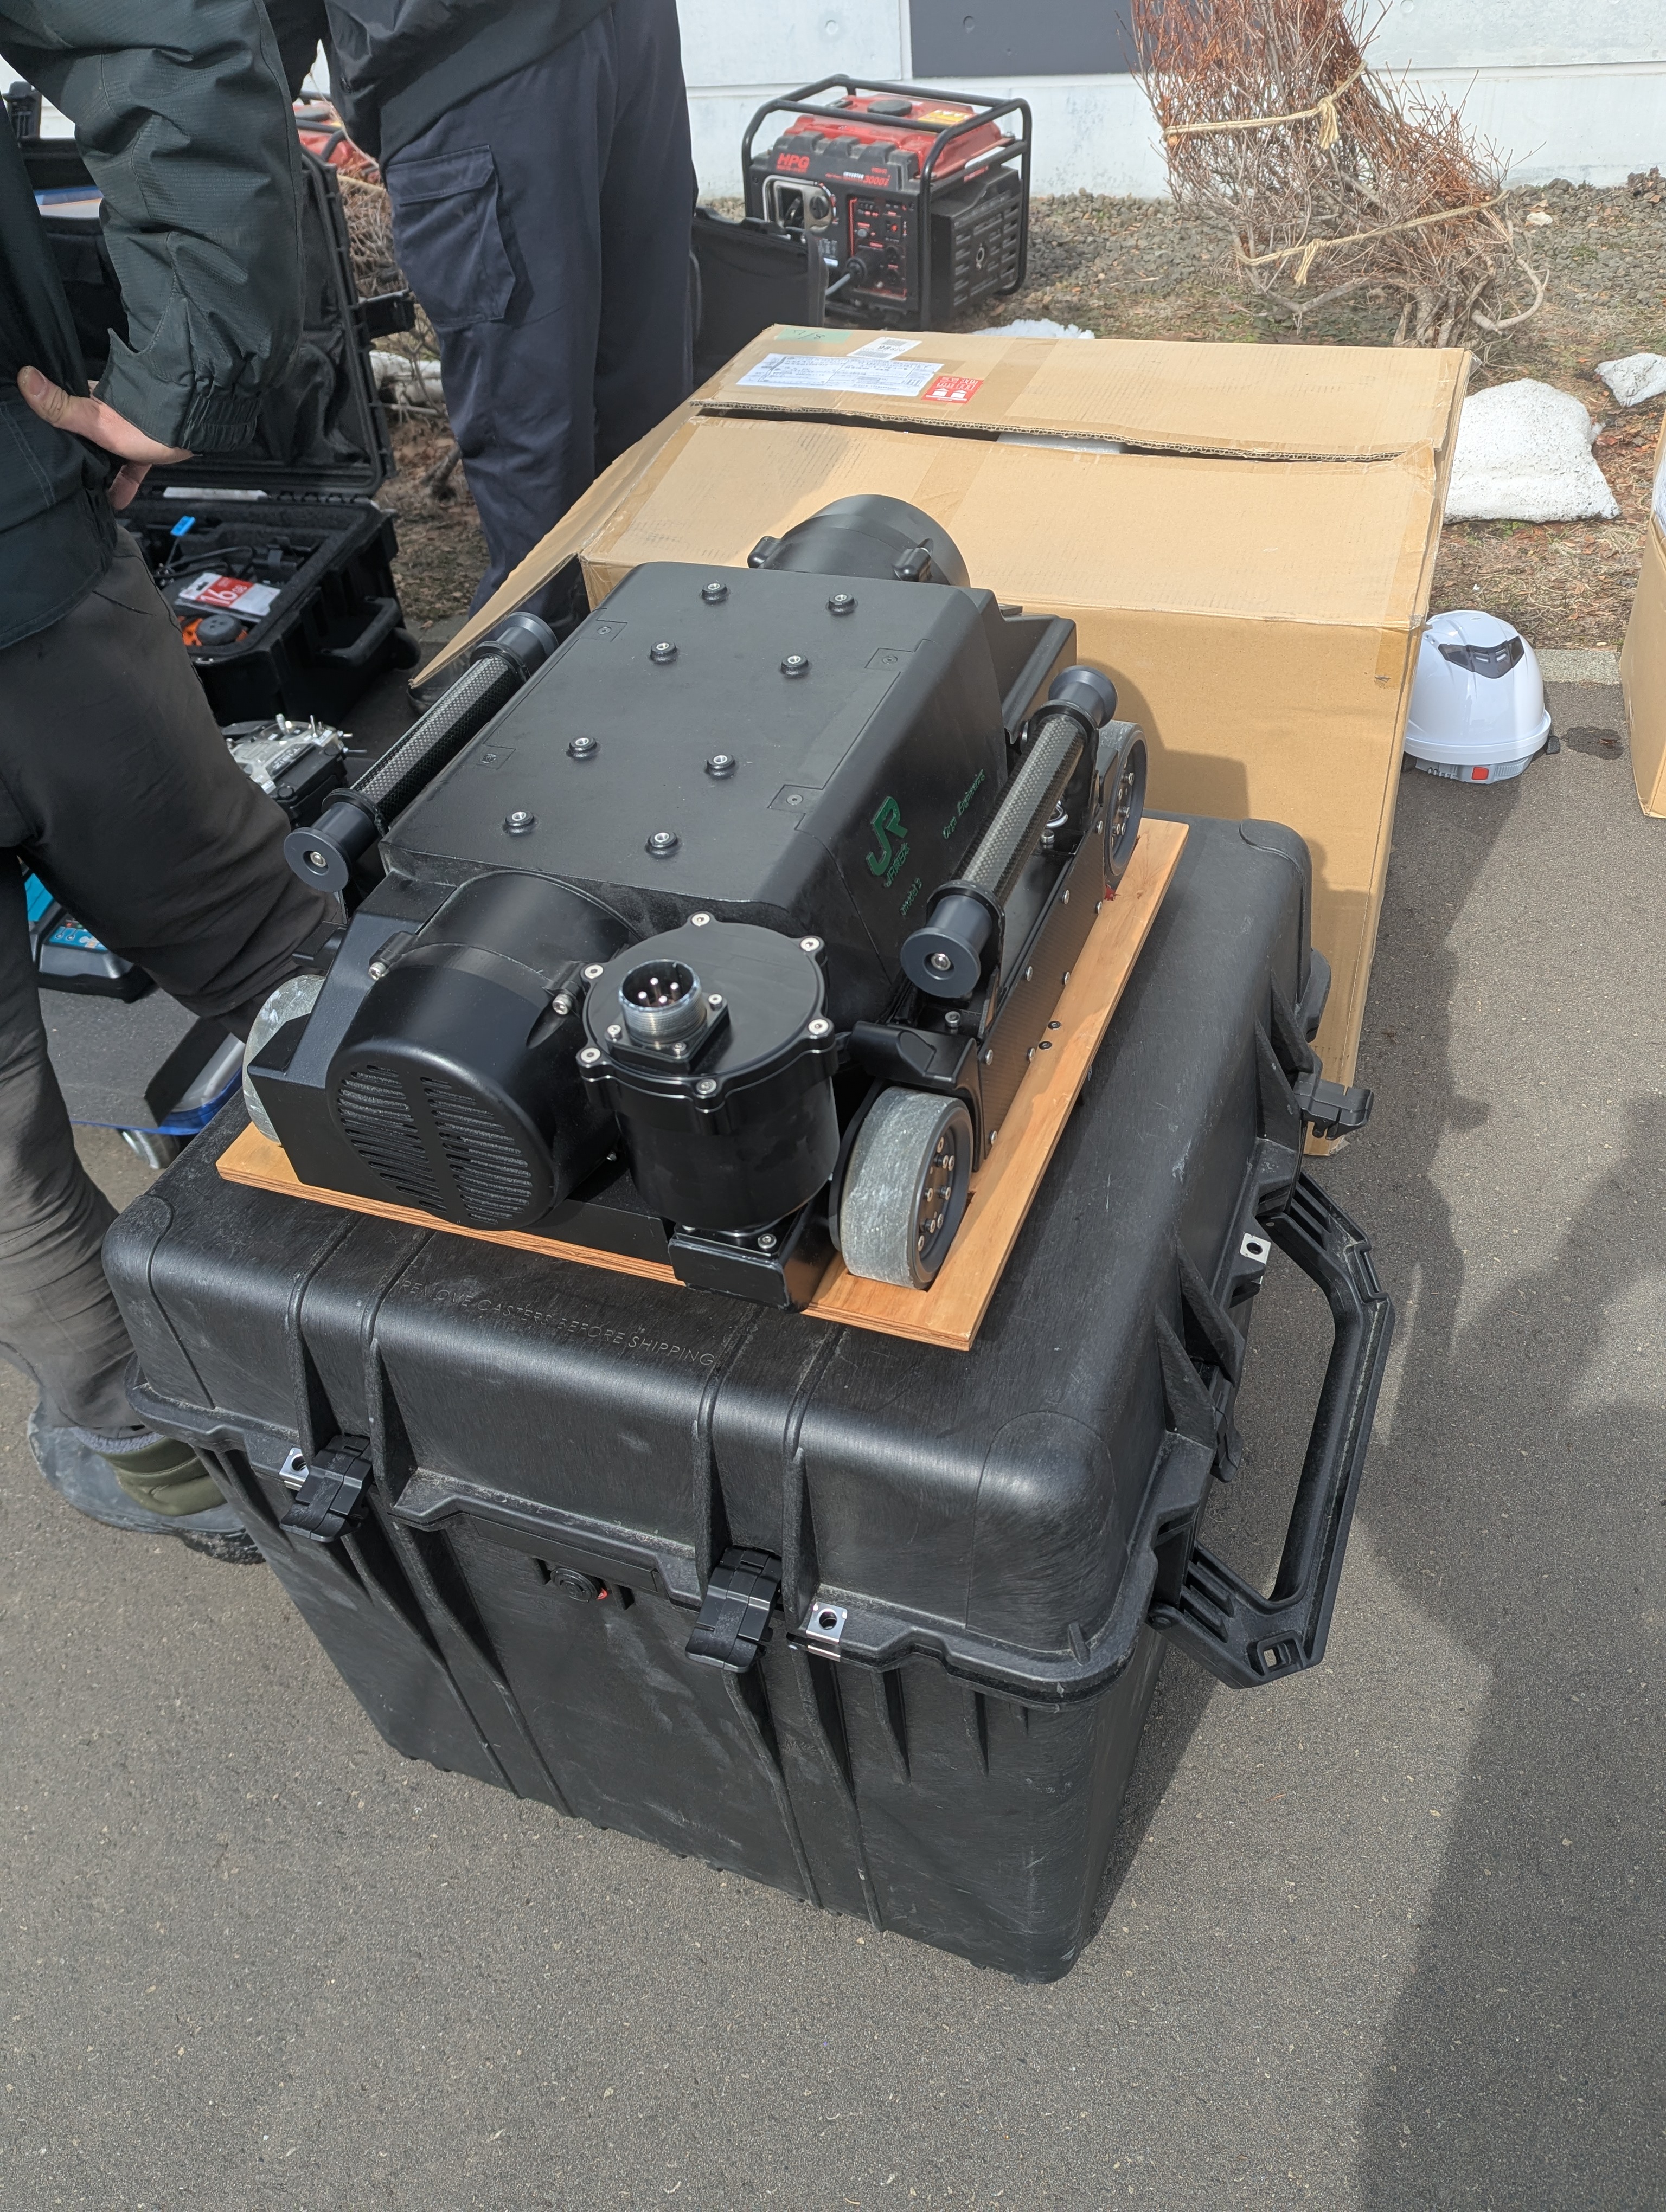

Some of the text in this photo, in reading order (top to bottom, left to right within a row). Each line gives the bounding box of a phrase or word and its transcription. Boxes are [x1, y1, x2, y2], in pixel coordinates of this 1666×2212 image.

[777, 152, 810, 169] HPG
[200, 588, 238, 605] 16
[957, 768, 985, 816] Engineering
[866, 796, 908, 876] JR
[399, 1279, 715, 1366] REMOVE CASTERS BEFORE SHIPPING
